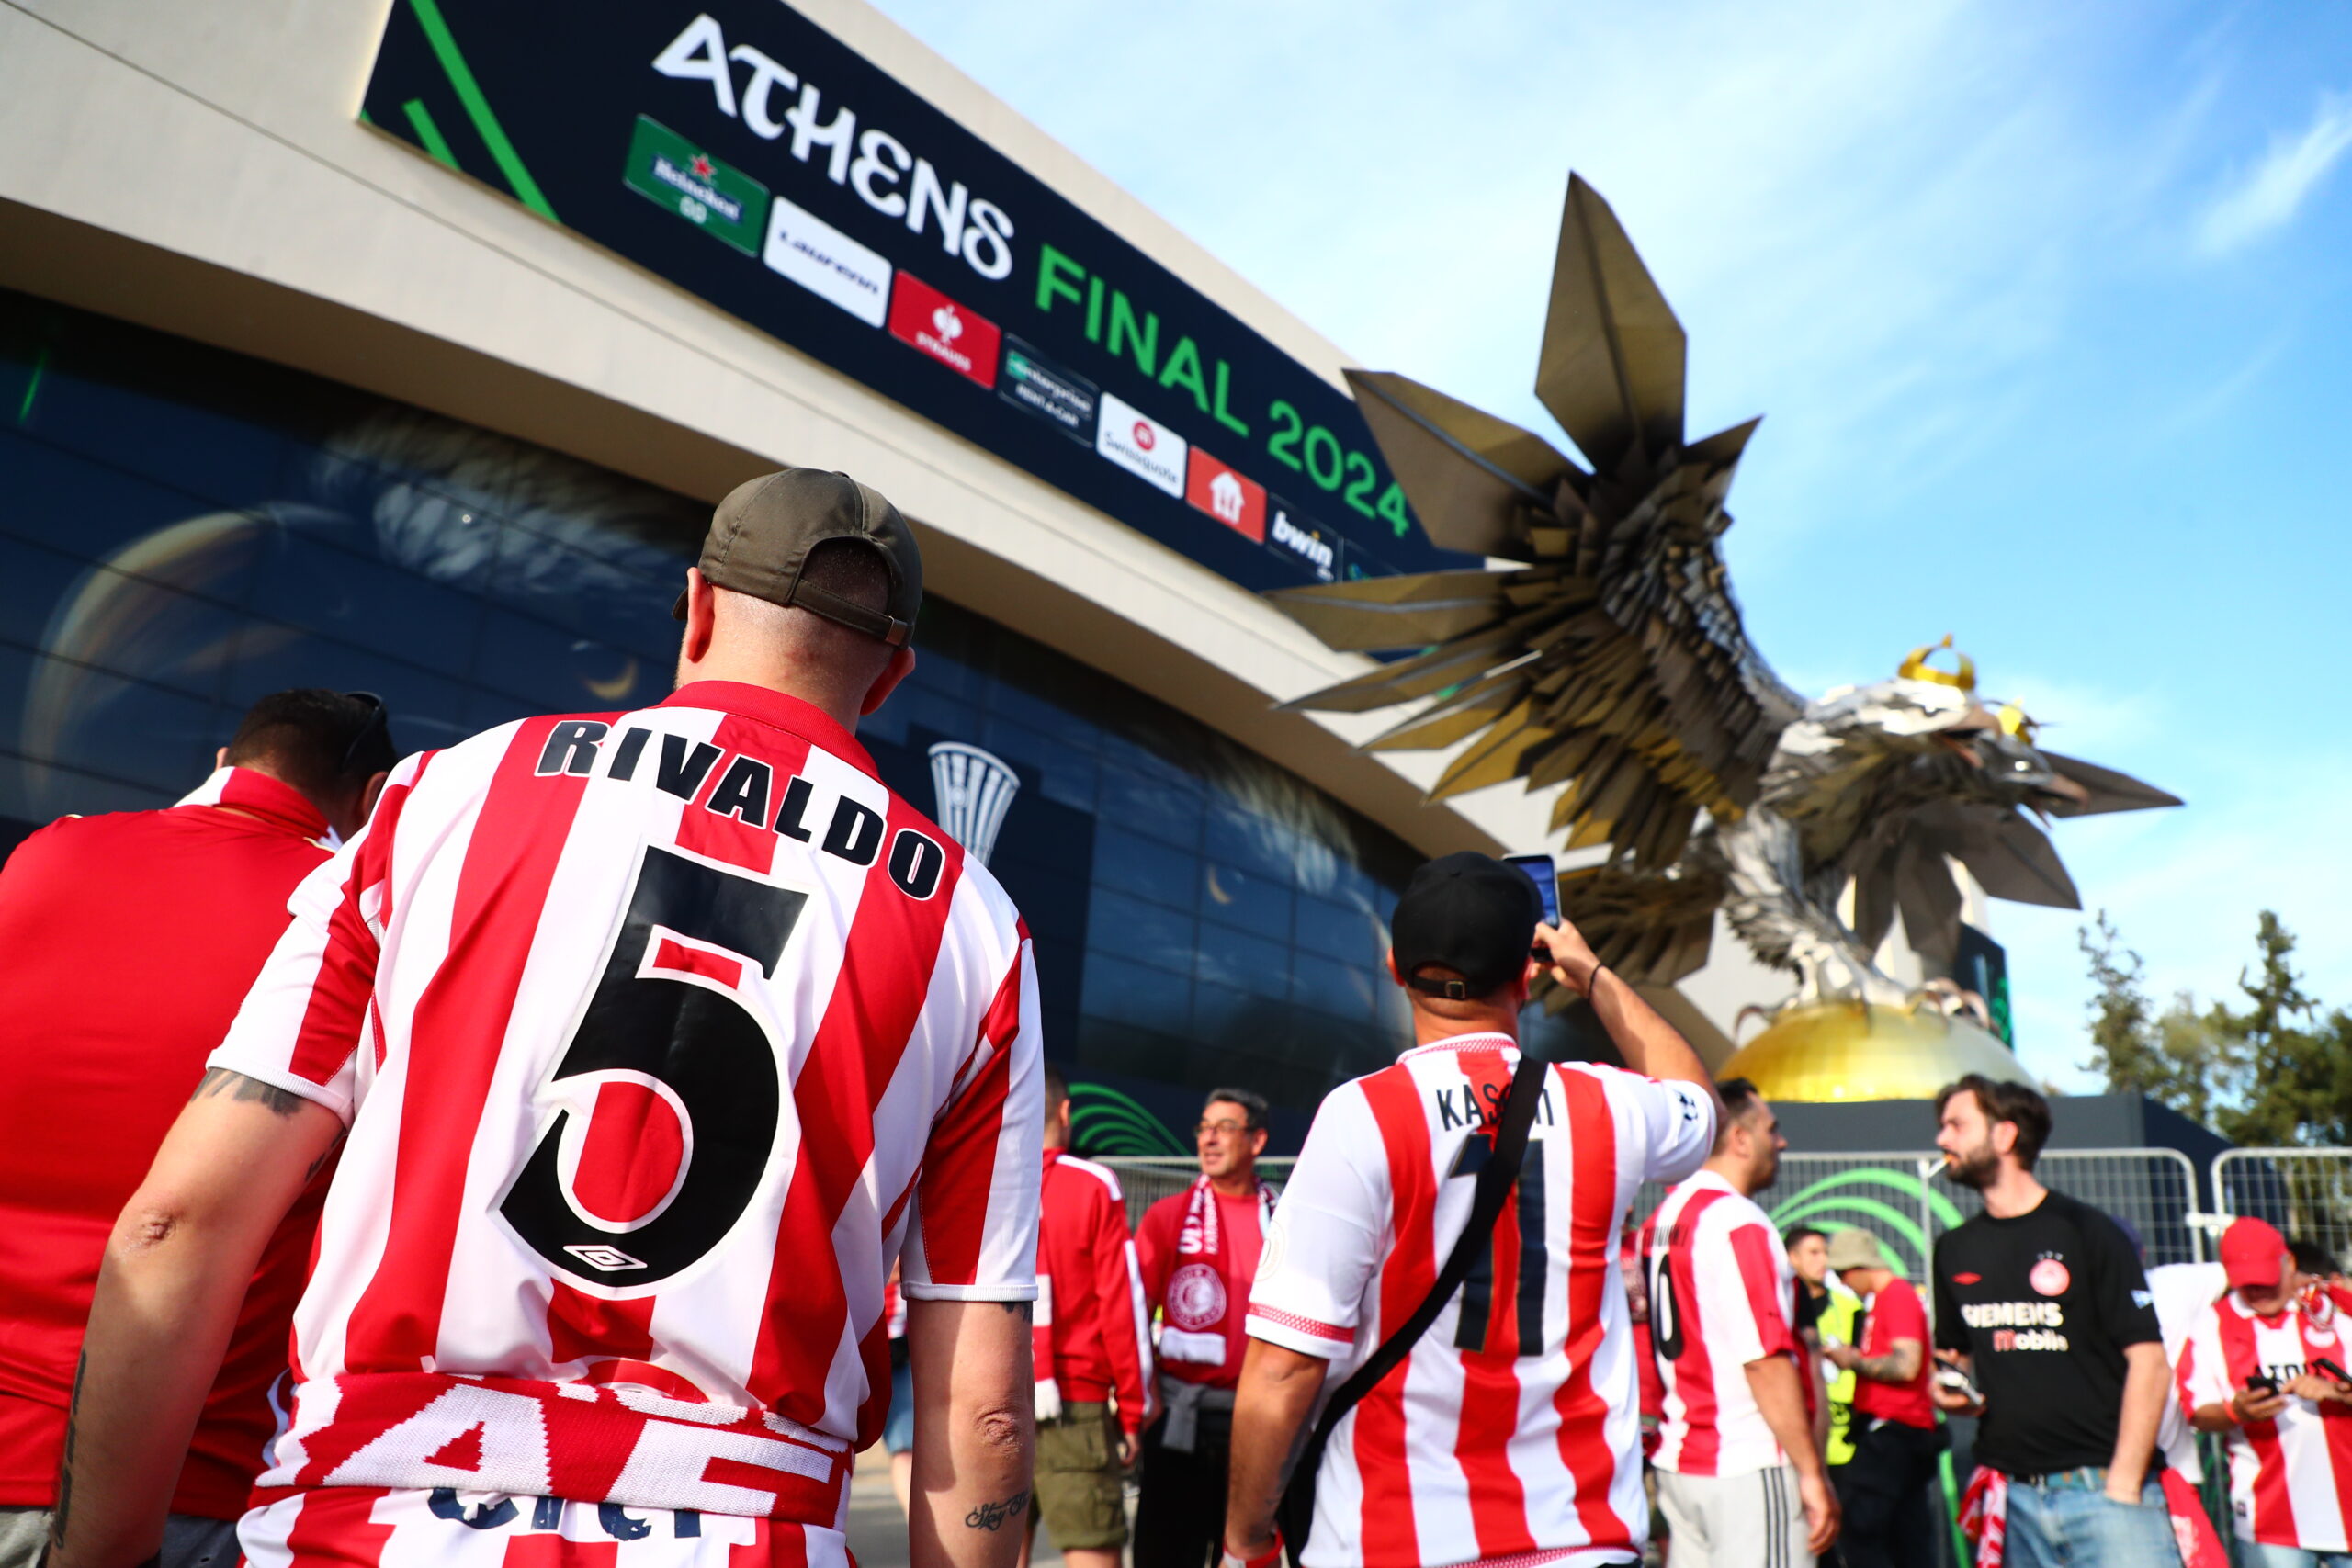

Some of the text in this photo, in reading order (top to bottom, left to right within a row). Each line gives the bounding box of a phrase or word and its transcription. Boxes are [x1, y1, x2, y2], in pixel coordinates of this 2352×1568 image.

[653, 157, 741, 221] Heineken
[651, 13, 1410, 538] ATHENS FINAL 2024
[1272, 510, 1333, 568] bwin
[535, 720, 945, 901] RIVALDO
[496, 843, 809, 1288] 5
[1961, 1302, 2064, 1327] SIEMENS
[1993, 1329, 2069, 1352] mobile
